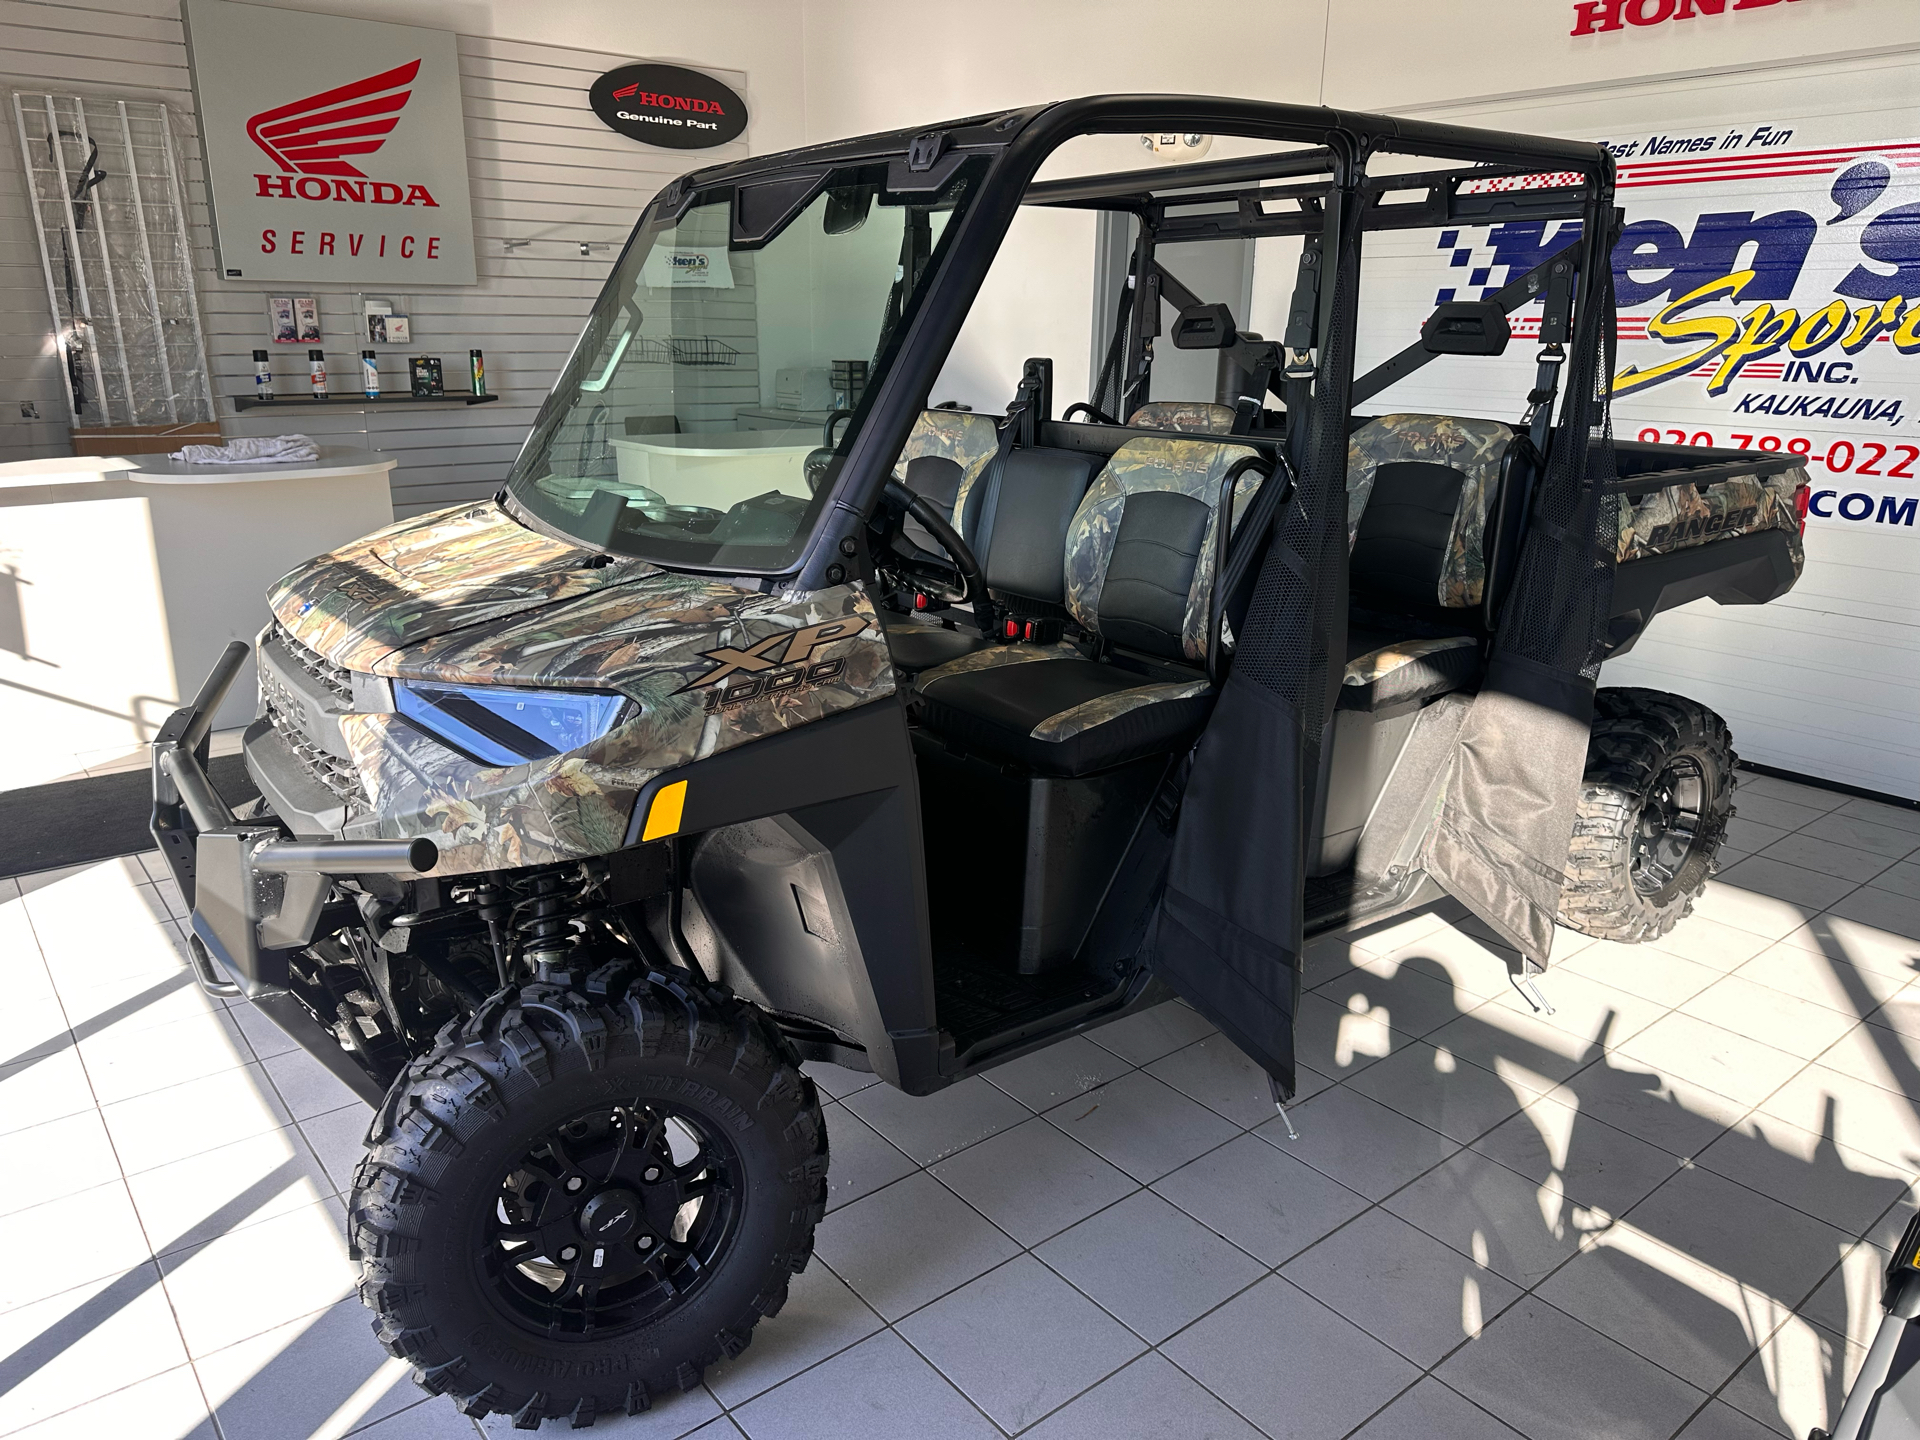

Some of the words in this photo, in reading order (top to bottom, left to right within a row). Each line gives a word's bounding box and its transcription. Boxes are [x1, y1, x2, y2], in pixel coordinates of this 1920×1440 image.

[1570, 0, 1808, 36] HON
[639, 92, 725, 115] HONDA
[616, 110, 683, 126] Genuine
[686, 119, 718, 130] Part
[1640, 134, 1714, 156] Names
[1719, 129, 1743, 151] in
[1745, 126, 1794, 148] Fun
[253, 174, 440, 207] HONDA
[261, 229, 441, 259] SERVICE
[1782, 361, 1859, 385] INC.
[1733, 393, 1905, 427] KAUKAUNA,
[1144, 456, 1210, 475] POLARIS
[1645, 505, 1758, 548] RANGER
[333, 583, 381, 604] XP
[670, 613, 872, 696] XP
[703, 656, 847, 711] 1000
[603, 1073, 755, 1133] X-TERRAIN
